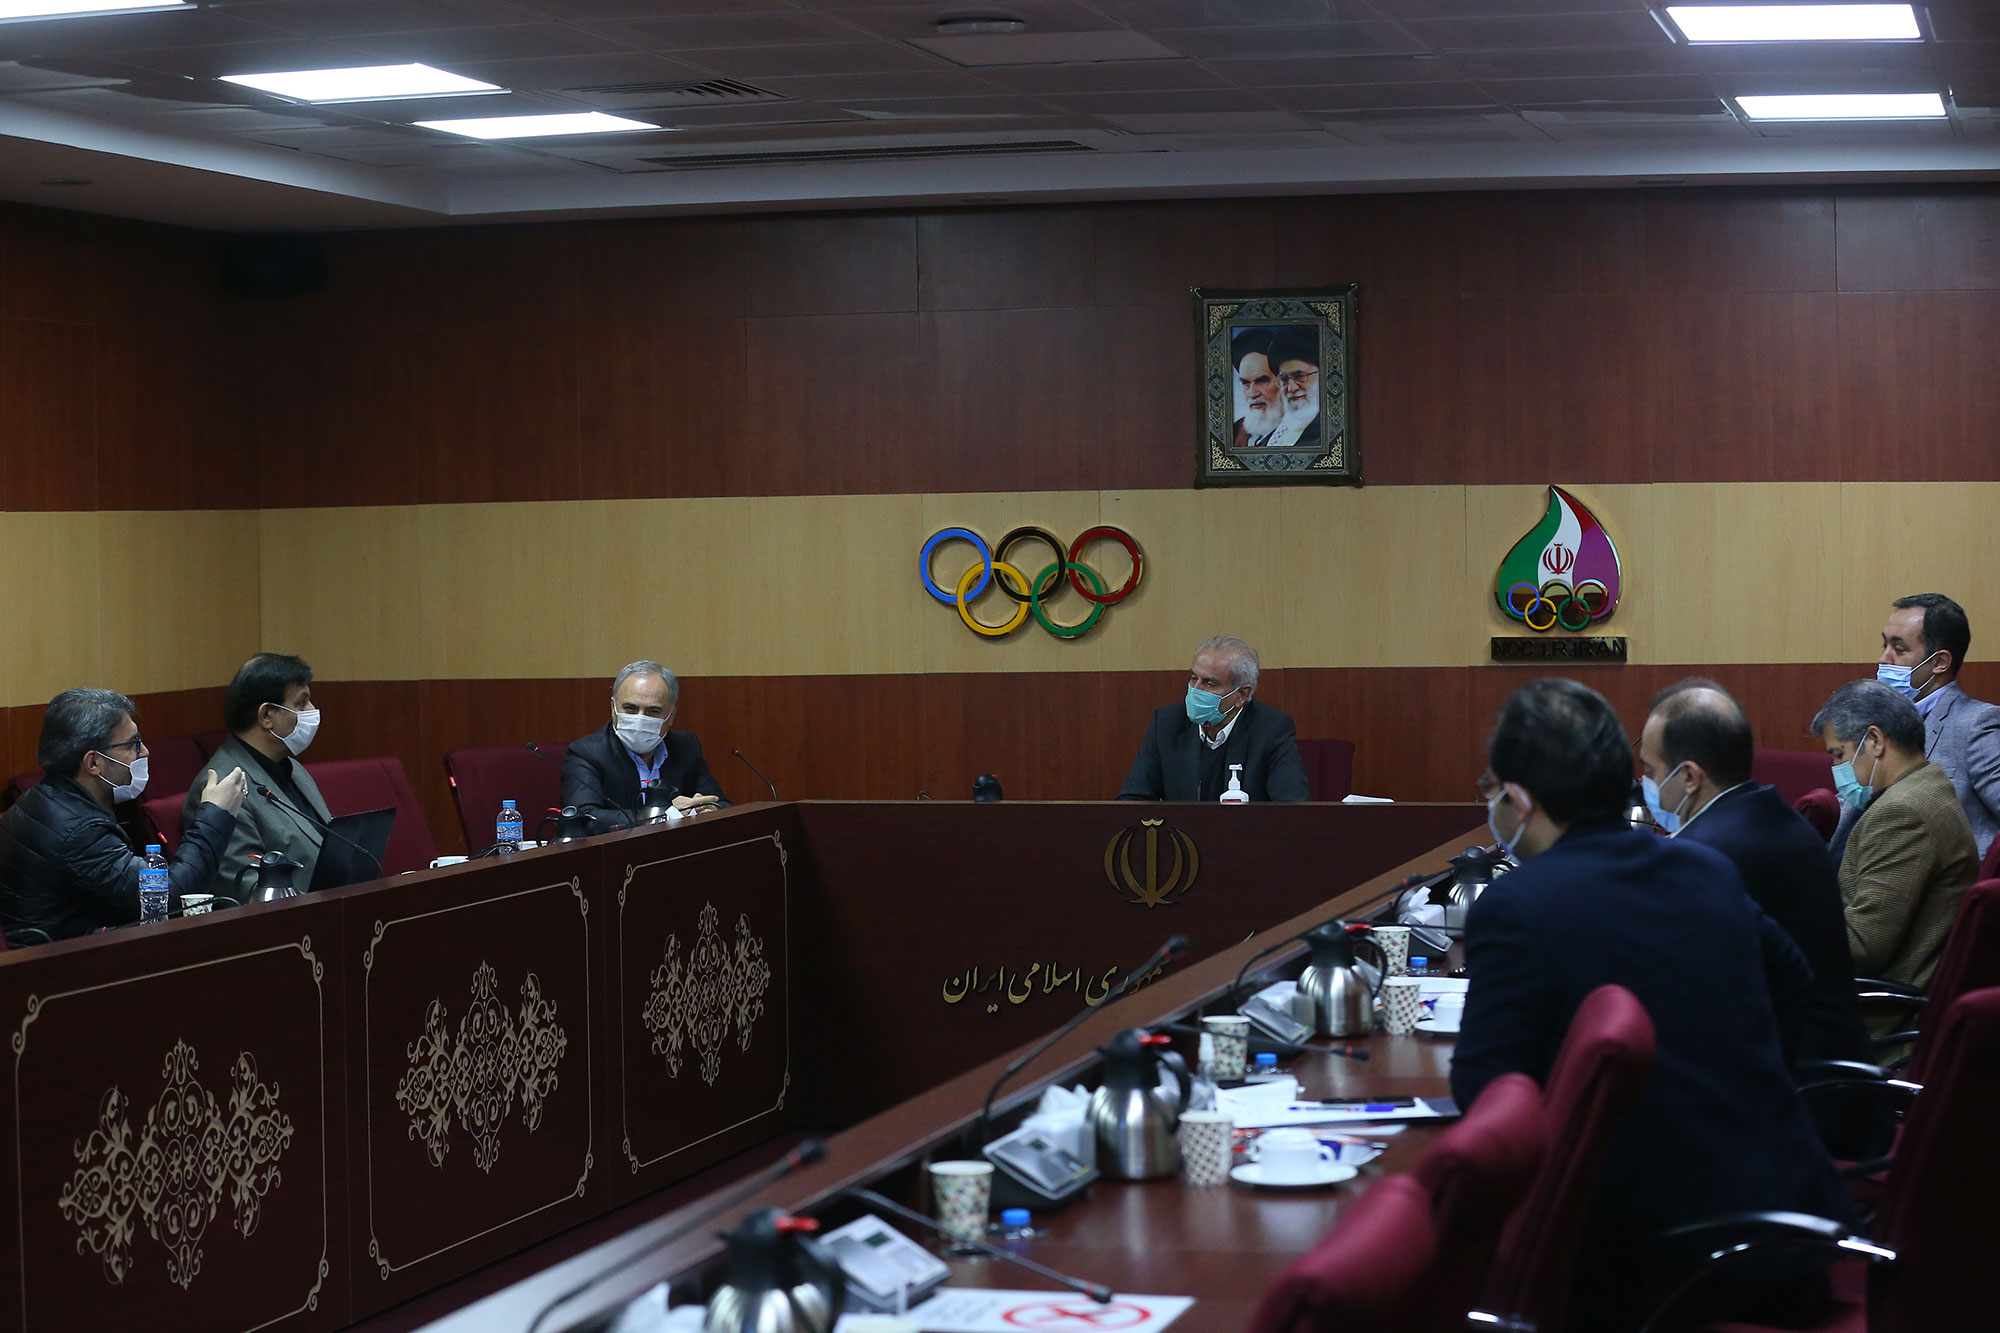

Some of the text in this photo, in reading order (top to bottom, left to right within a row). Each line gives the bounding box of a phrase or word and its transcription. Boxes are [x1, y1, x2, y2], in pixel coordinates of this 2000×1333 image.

[1492, 640, 1535, 657] NOC
[942, 965, 1004, 1013] ایران
[1007, 961, 1081, 1004] اسلامی
